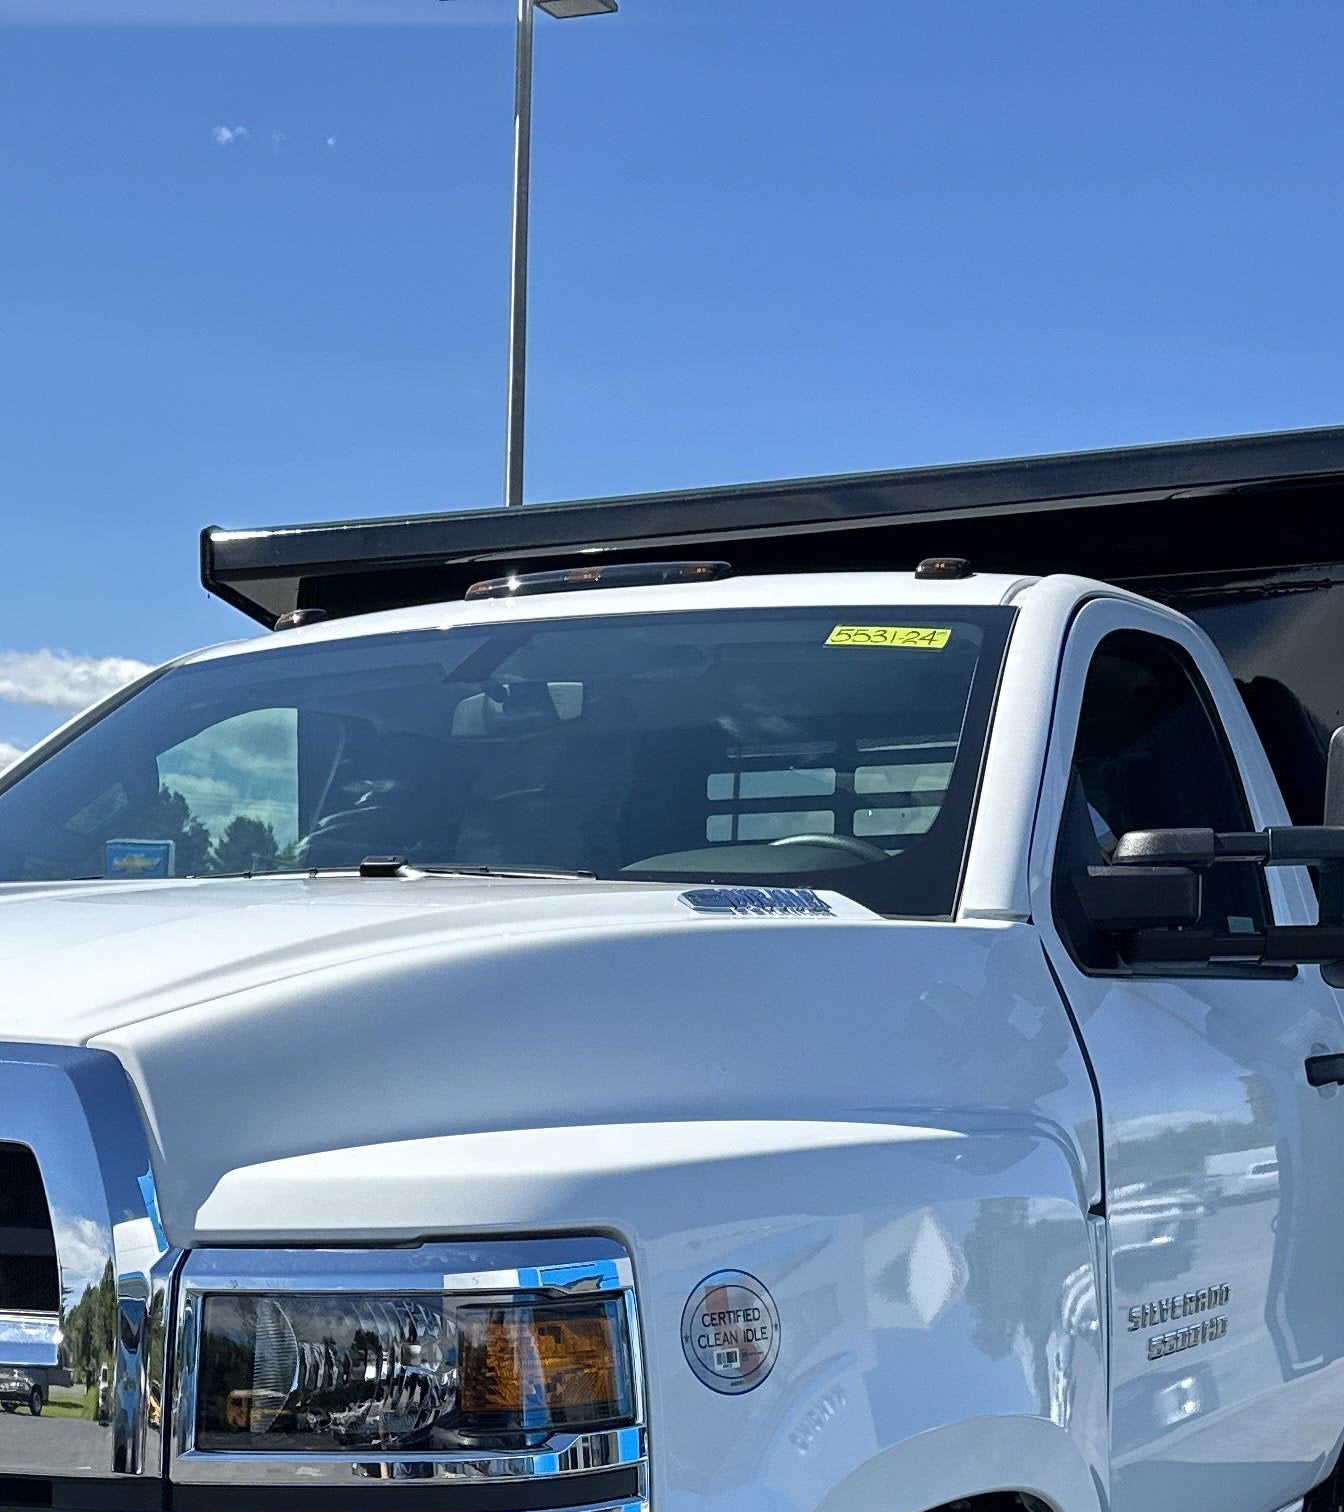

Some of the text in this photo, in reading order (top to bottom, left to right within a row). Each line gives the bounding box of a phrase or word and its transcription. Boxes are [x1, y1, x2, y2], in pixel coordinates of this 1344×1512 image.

[830, 628, 939, 646] 5531-24
[701, 1307, 761, 1328] CERTIFIED
[697, 1326, 769, 1349] CLEAN IDLE
